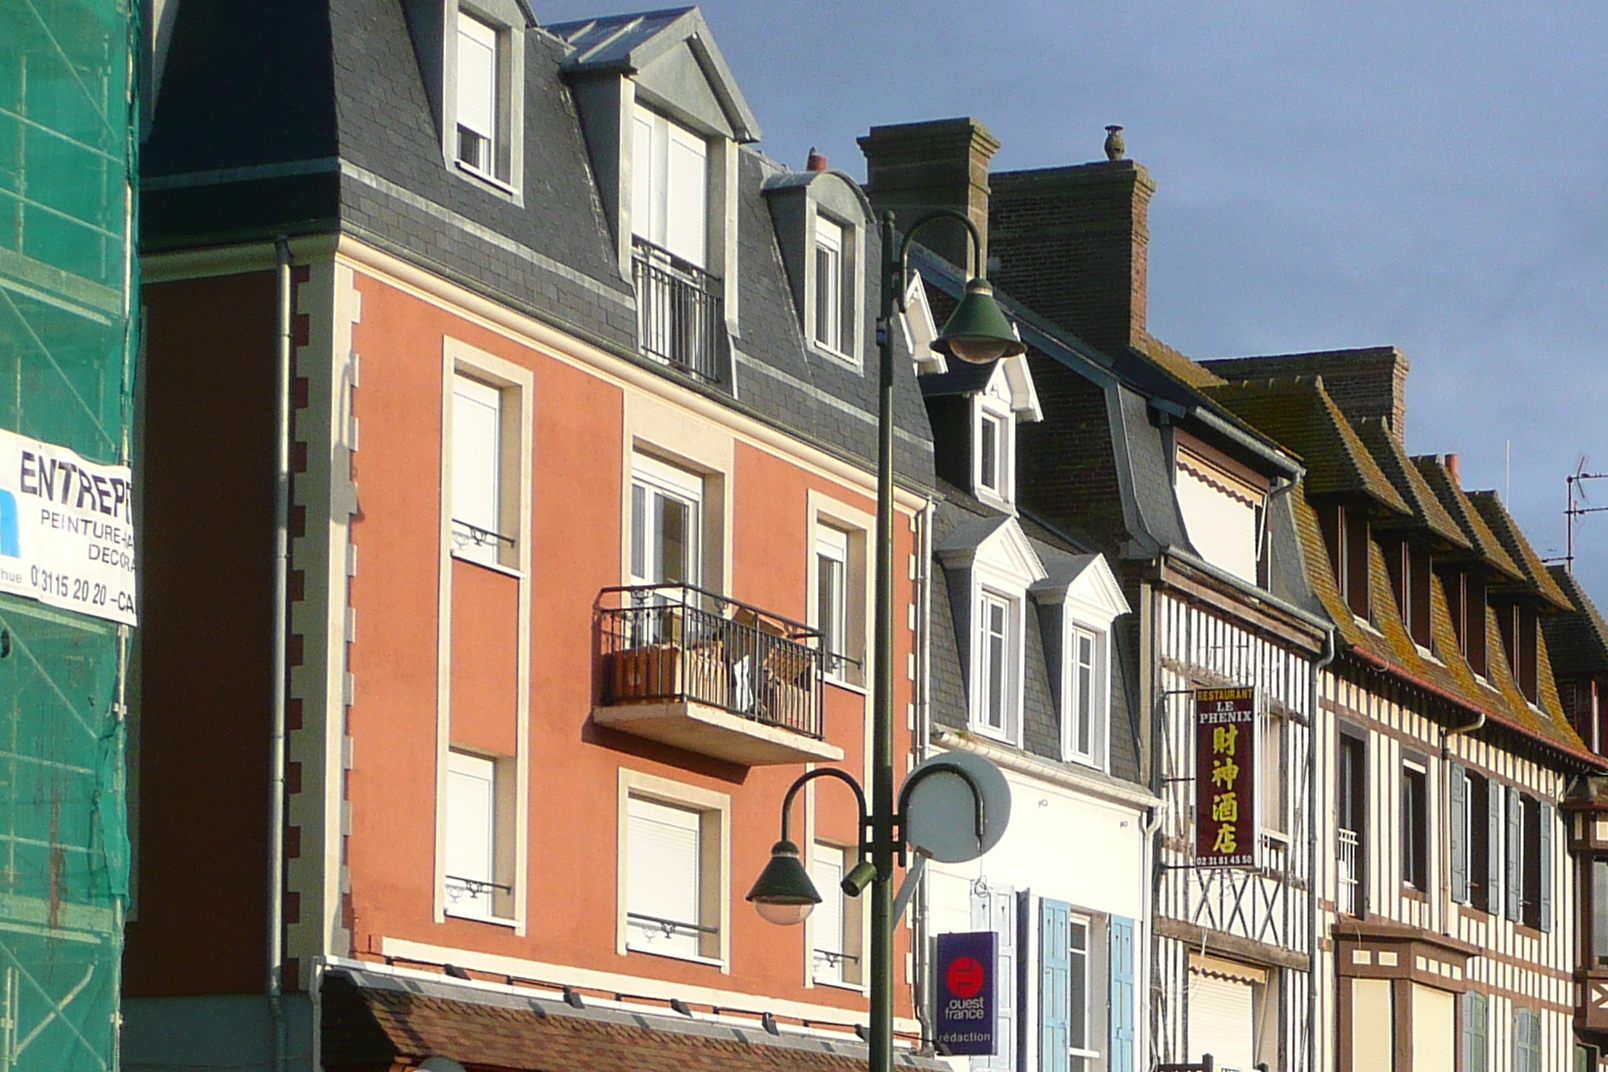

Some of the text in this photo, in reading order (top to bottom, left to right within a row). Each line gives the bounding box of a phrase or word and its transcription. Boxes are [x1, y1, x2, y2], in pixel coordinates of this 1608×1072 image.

[73, 578, 89, 602] 20
[92, 582, 107, 606] 20
[1197, 688, 1253, 701] RESTAURANT
[1216, 701, 1235, 712] LE
[1199, 710, 1252, 724] PHENIX
[949, 996, 984, 1010] ouest
[945, 1007, 984, 1020] france
[940, 1032, 991, 1043] rédaction
